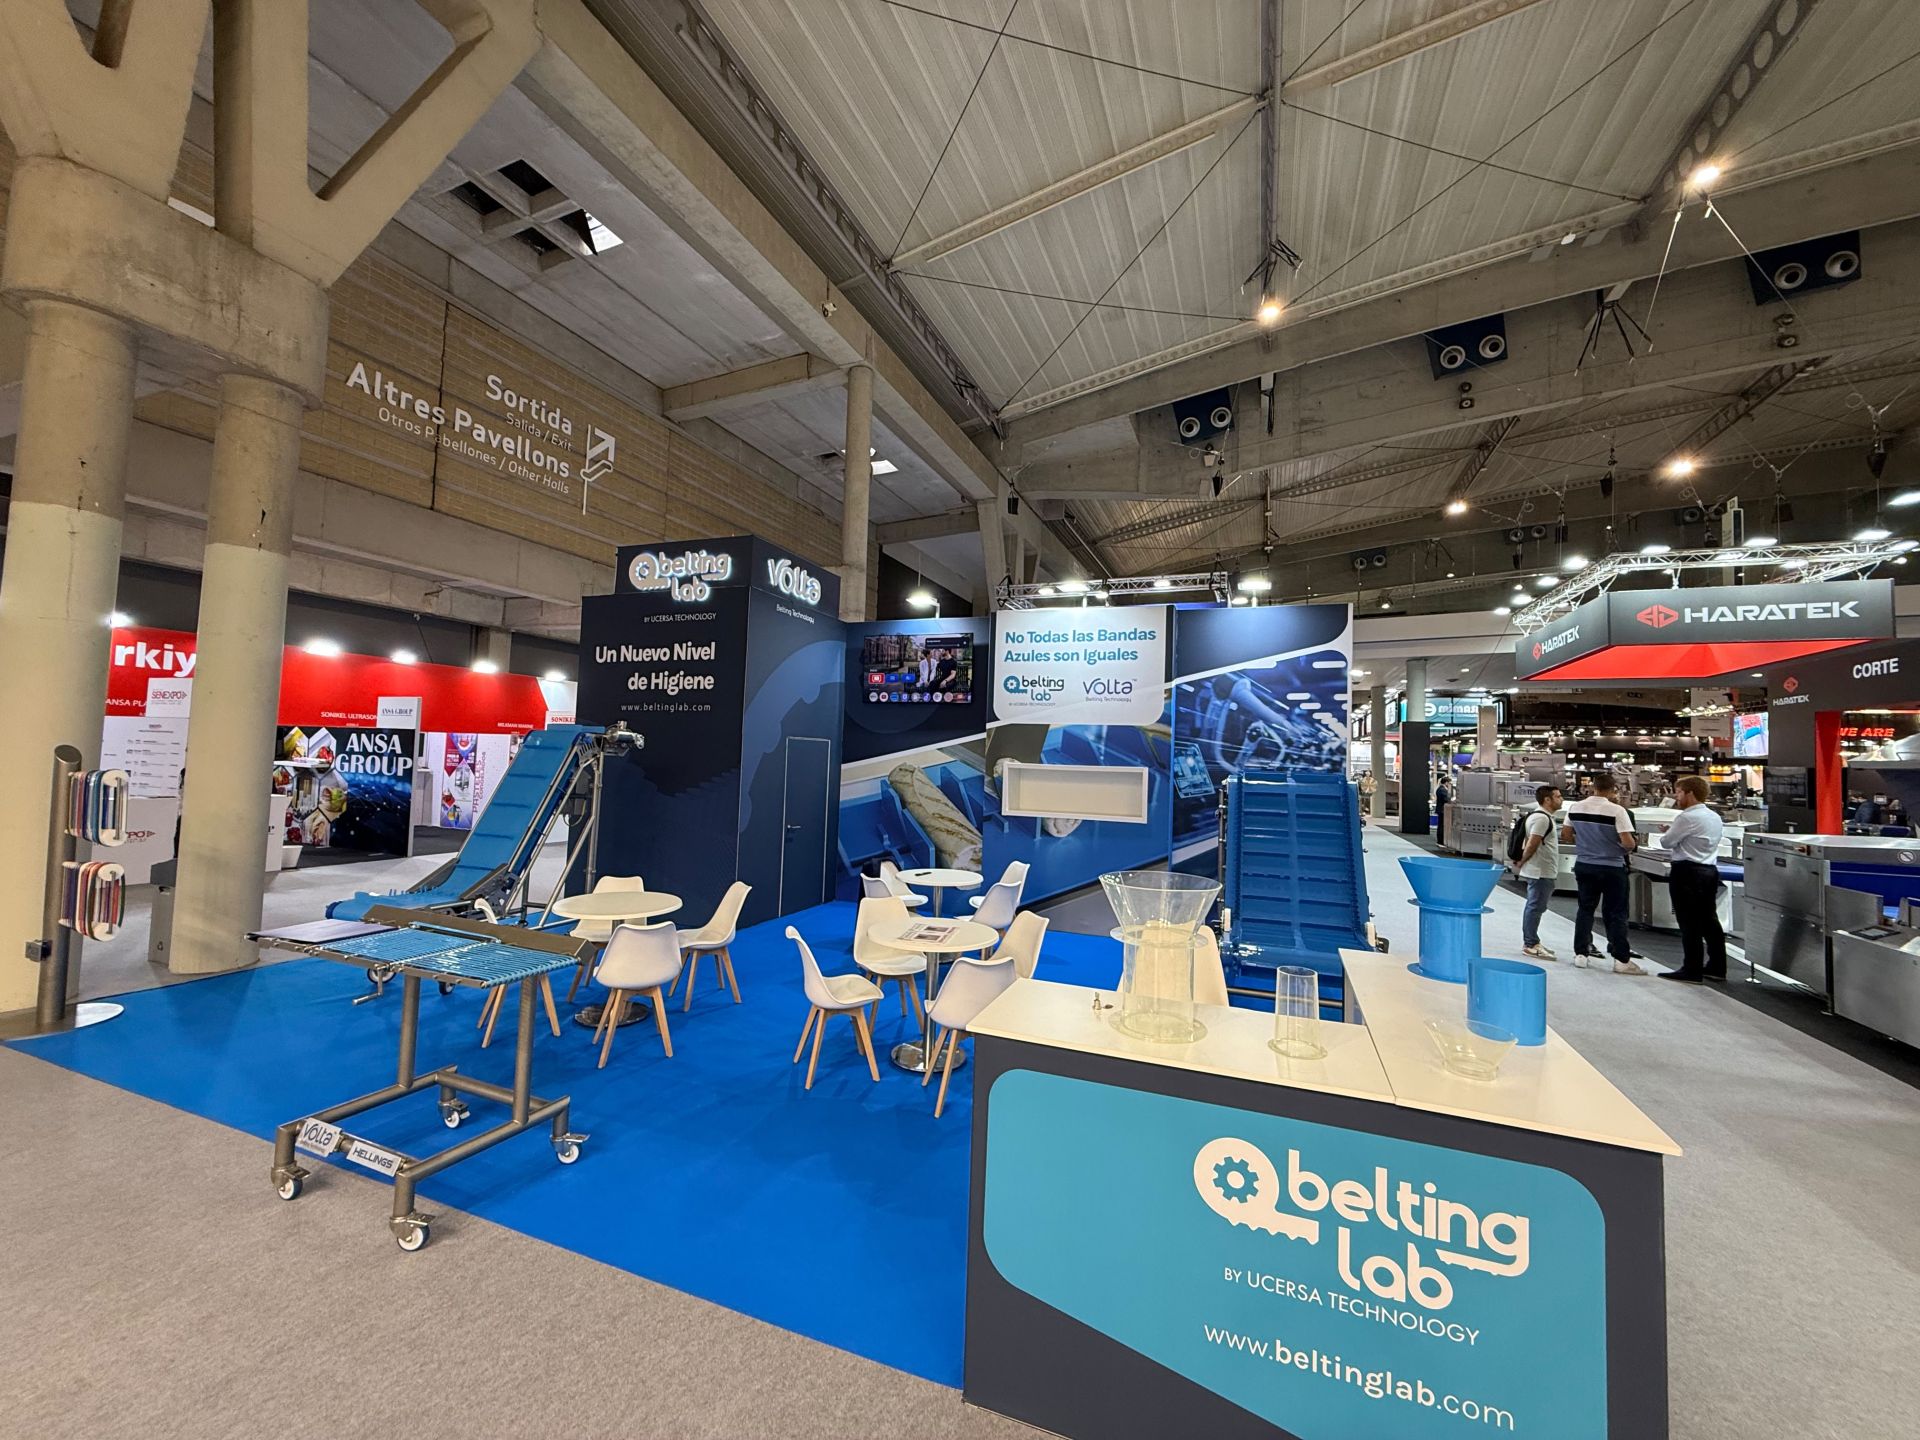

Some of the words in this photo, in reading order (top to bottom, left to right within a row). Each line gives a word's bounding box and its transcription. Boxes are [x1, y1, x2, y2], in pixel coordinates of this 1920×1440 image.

[486, 374, 572, 436] Sortida
[346, 361, 446, 425] Altres
[454, 407, 570, 478] Pavellons
[506, 411, 542, 438] Salida
[551, 432, 573, 452] Exit
[378, 406, 422, 436] Otros
[425, 427, 497, 466] Pabellones
[508, 460, 541, 486] Other
[543, 477, 570, 495] Halls
[658, 549, 732, 581] belting
[671, 576, 711, 602] lab
[651, 615, 674, 623] UCERSA
[674, 613, 717, 622] TECHNOLOGY
[1684, 600, 1861, 624] HARATEK
[1005, 631, 1024, 645] No
[1027, 629, 1069, 643] Todas
[1072, 629, 1094, 642] las
[1098, 628, 1157, 642] Bandas
[1541, 625, 1580, 655] HARATEK
[595, 646, 617, 663] Un
[620, 643, 670, 663] Nuevo
[673, 642, 716, 661] Nivel
[1004, 649, 1051, 663] Azules
[1054, 650, 1079, 662] son
[1083, 648, 1139, 665] Iguales
[1852, 657, 1900, 679] CORTE
[627, 673, 648, 690] de
[651, 671, 715, 696] Higiene
[1021, 675, 1065, 692] belting
[1031, 689, 1051, 701] lab
[621, 702, 711, 713] www.beltinglab.com
[1773, 694, 1810, 706] HARATEK
[346, 733, 402, 755] ANSA
[1861, 727, 1895, 737] ARE
[335, 753, 413, 777] GROUP
[353, 1146, 394, 1169] HELLINGS
[1288, 1148, 1530, 1277] belting
[1338, 1226, 1454, 1310] lab
[1224, 1266, 1242, 1283] BY
[1247, 1270, 1323, 1307] UCERSA
[1327, 1291, 1480, 1346] TECHNOLOGY
[1204, 1324, 1515, 1431] www.beltinglab.com
